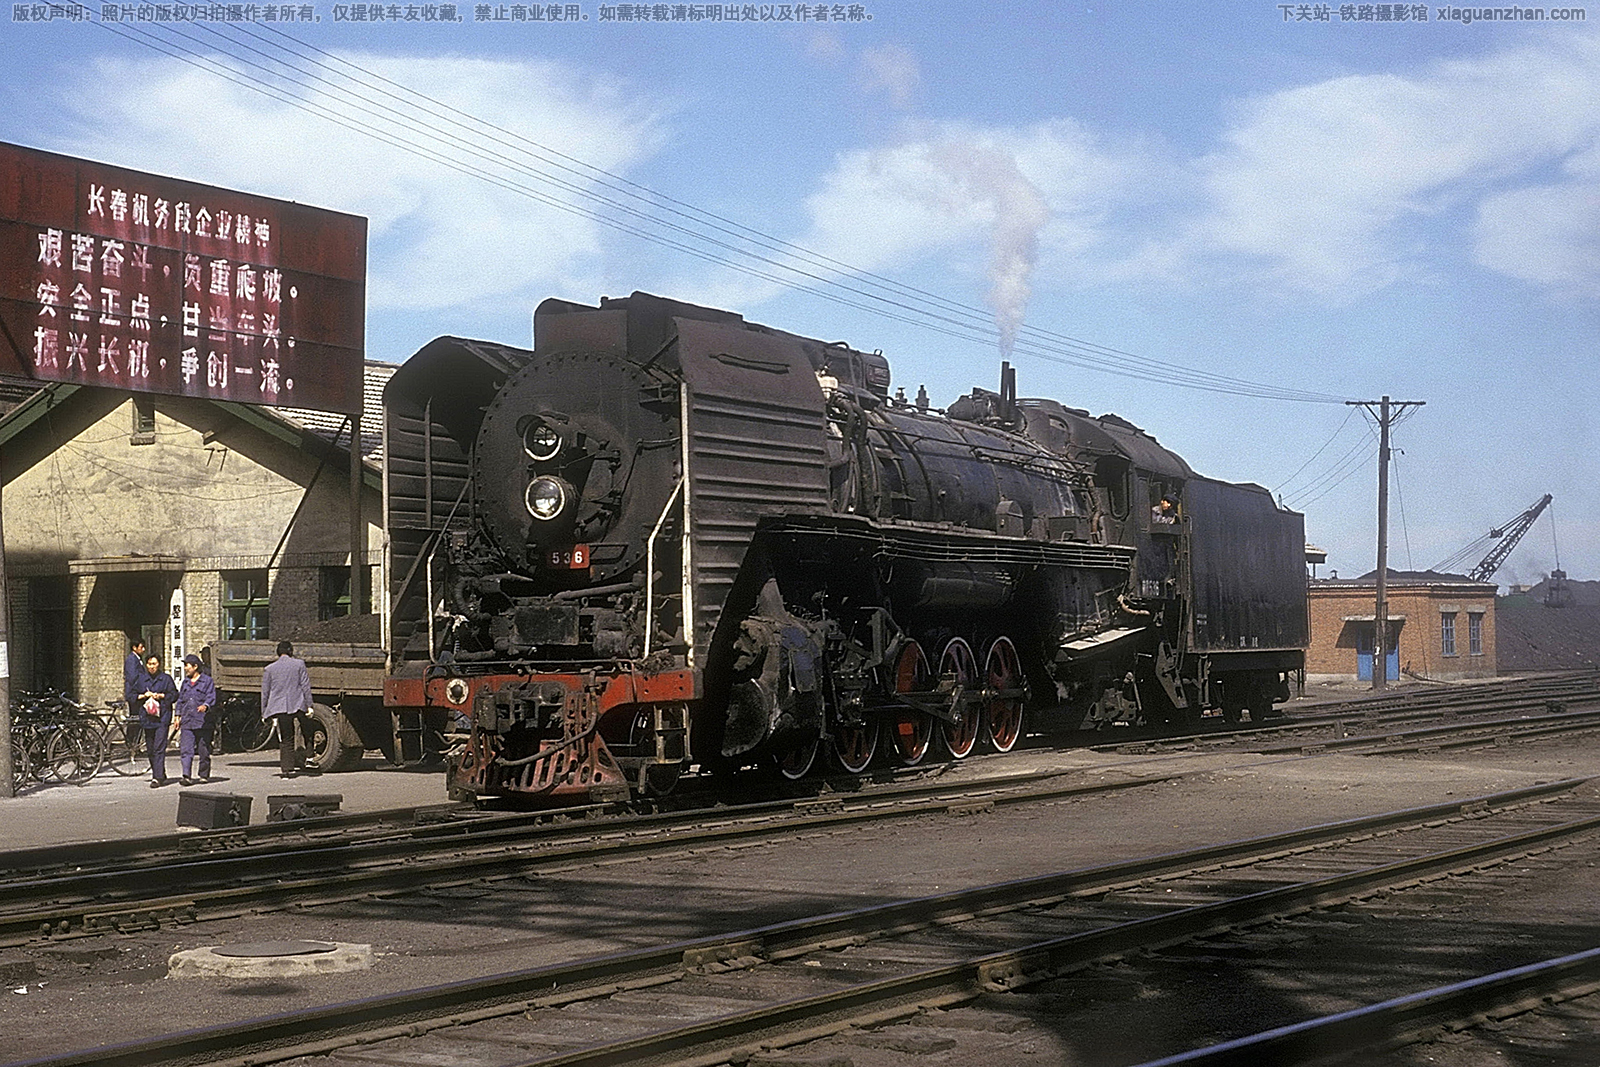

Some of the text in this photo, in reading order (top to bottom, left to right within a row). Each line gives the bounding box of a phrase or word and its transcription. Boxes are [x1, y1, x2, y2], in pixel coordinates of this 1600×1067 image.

[87, 183, 271, 248] 长春机务段企业精神
[552, 551, 583, 564] 536
